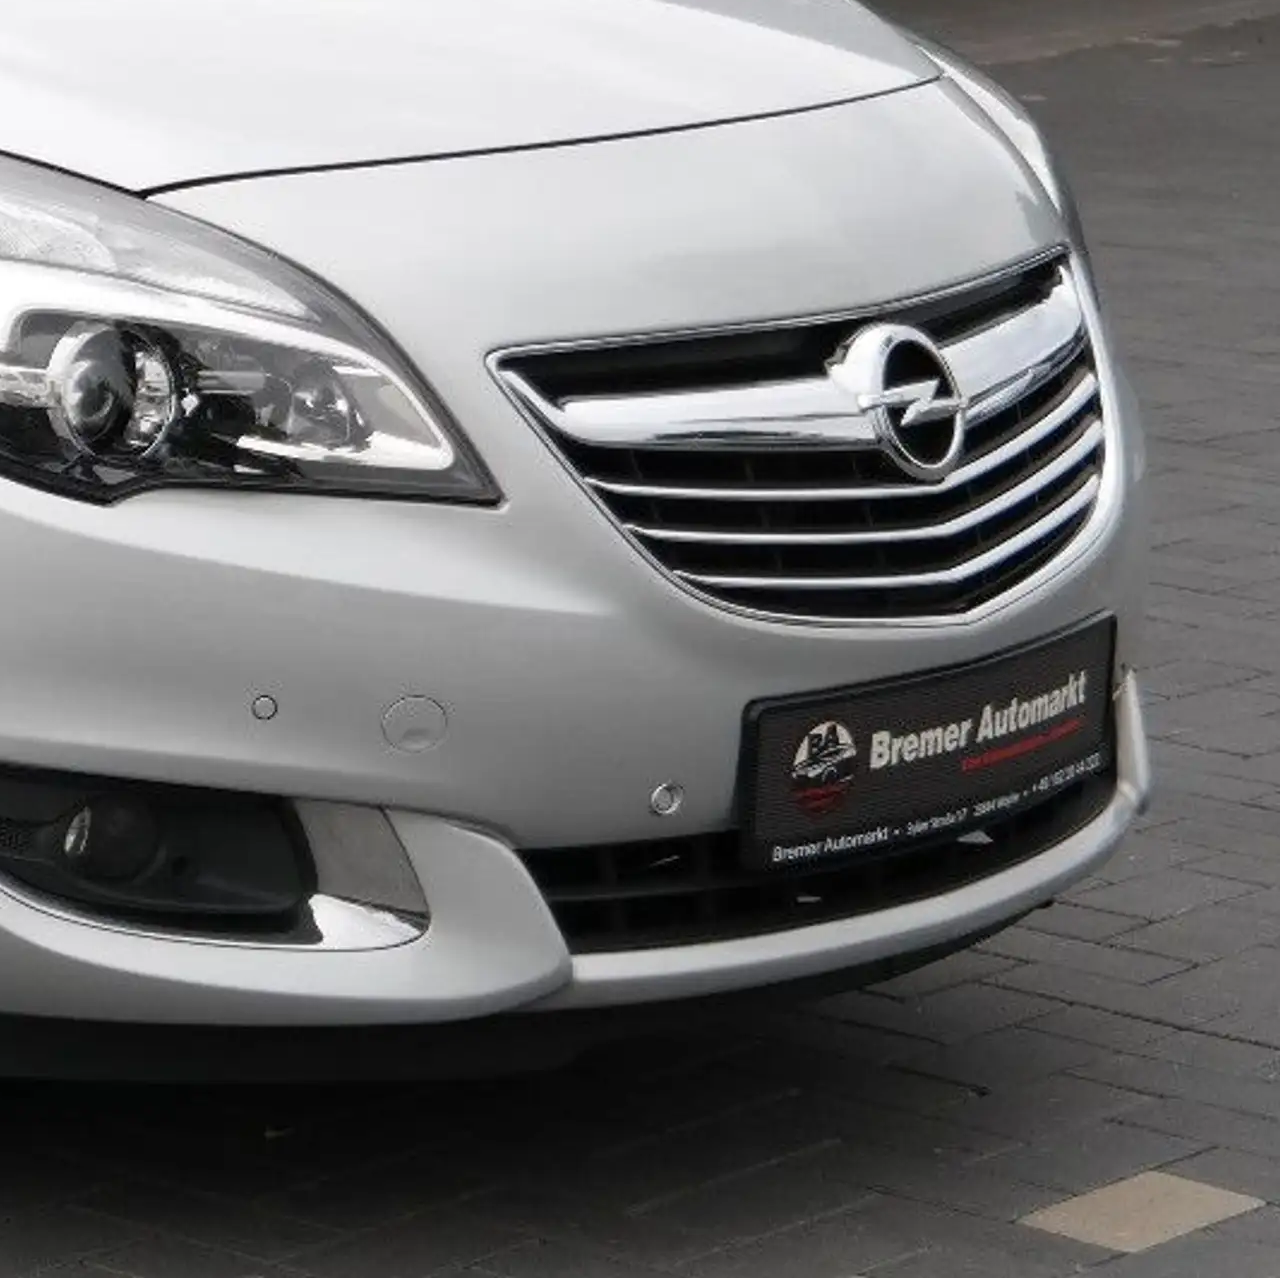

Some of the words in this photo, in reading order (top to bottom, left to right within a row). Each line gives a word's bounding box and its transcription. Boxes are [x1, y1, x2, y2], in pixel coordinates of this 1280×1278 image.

[870, 718, 973, 769] Bremer
[975, 670, 1088, 743] Automarkt
[772, 842, 822, 862] Bremer
[823, 826, 888, 853] Automarkt
